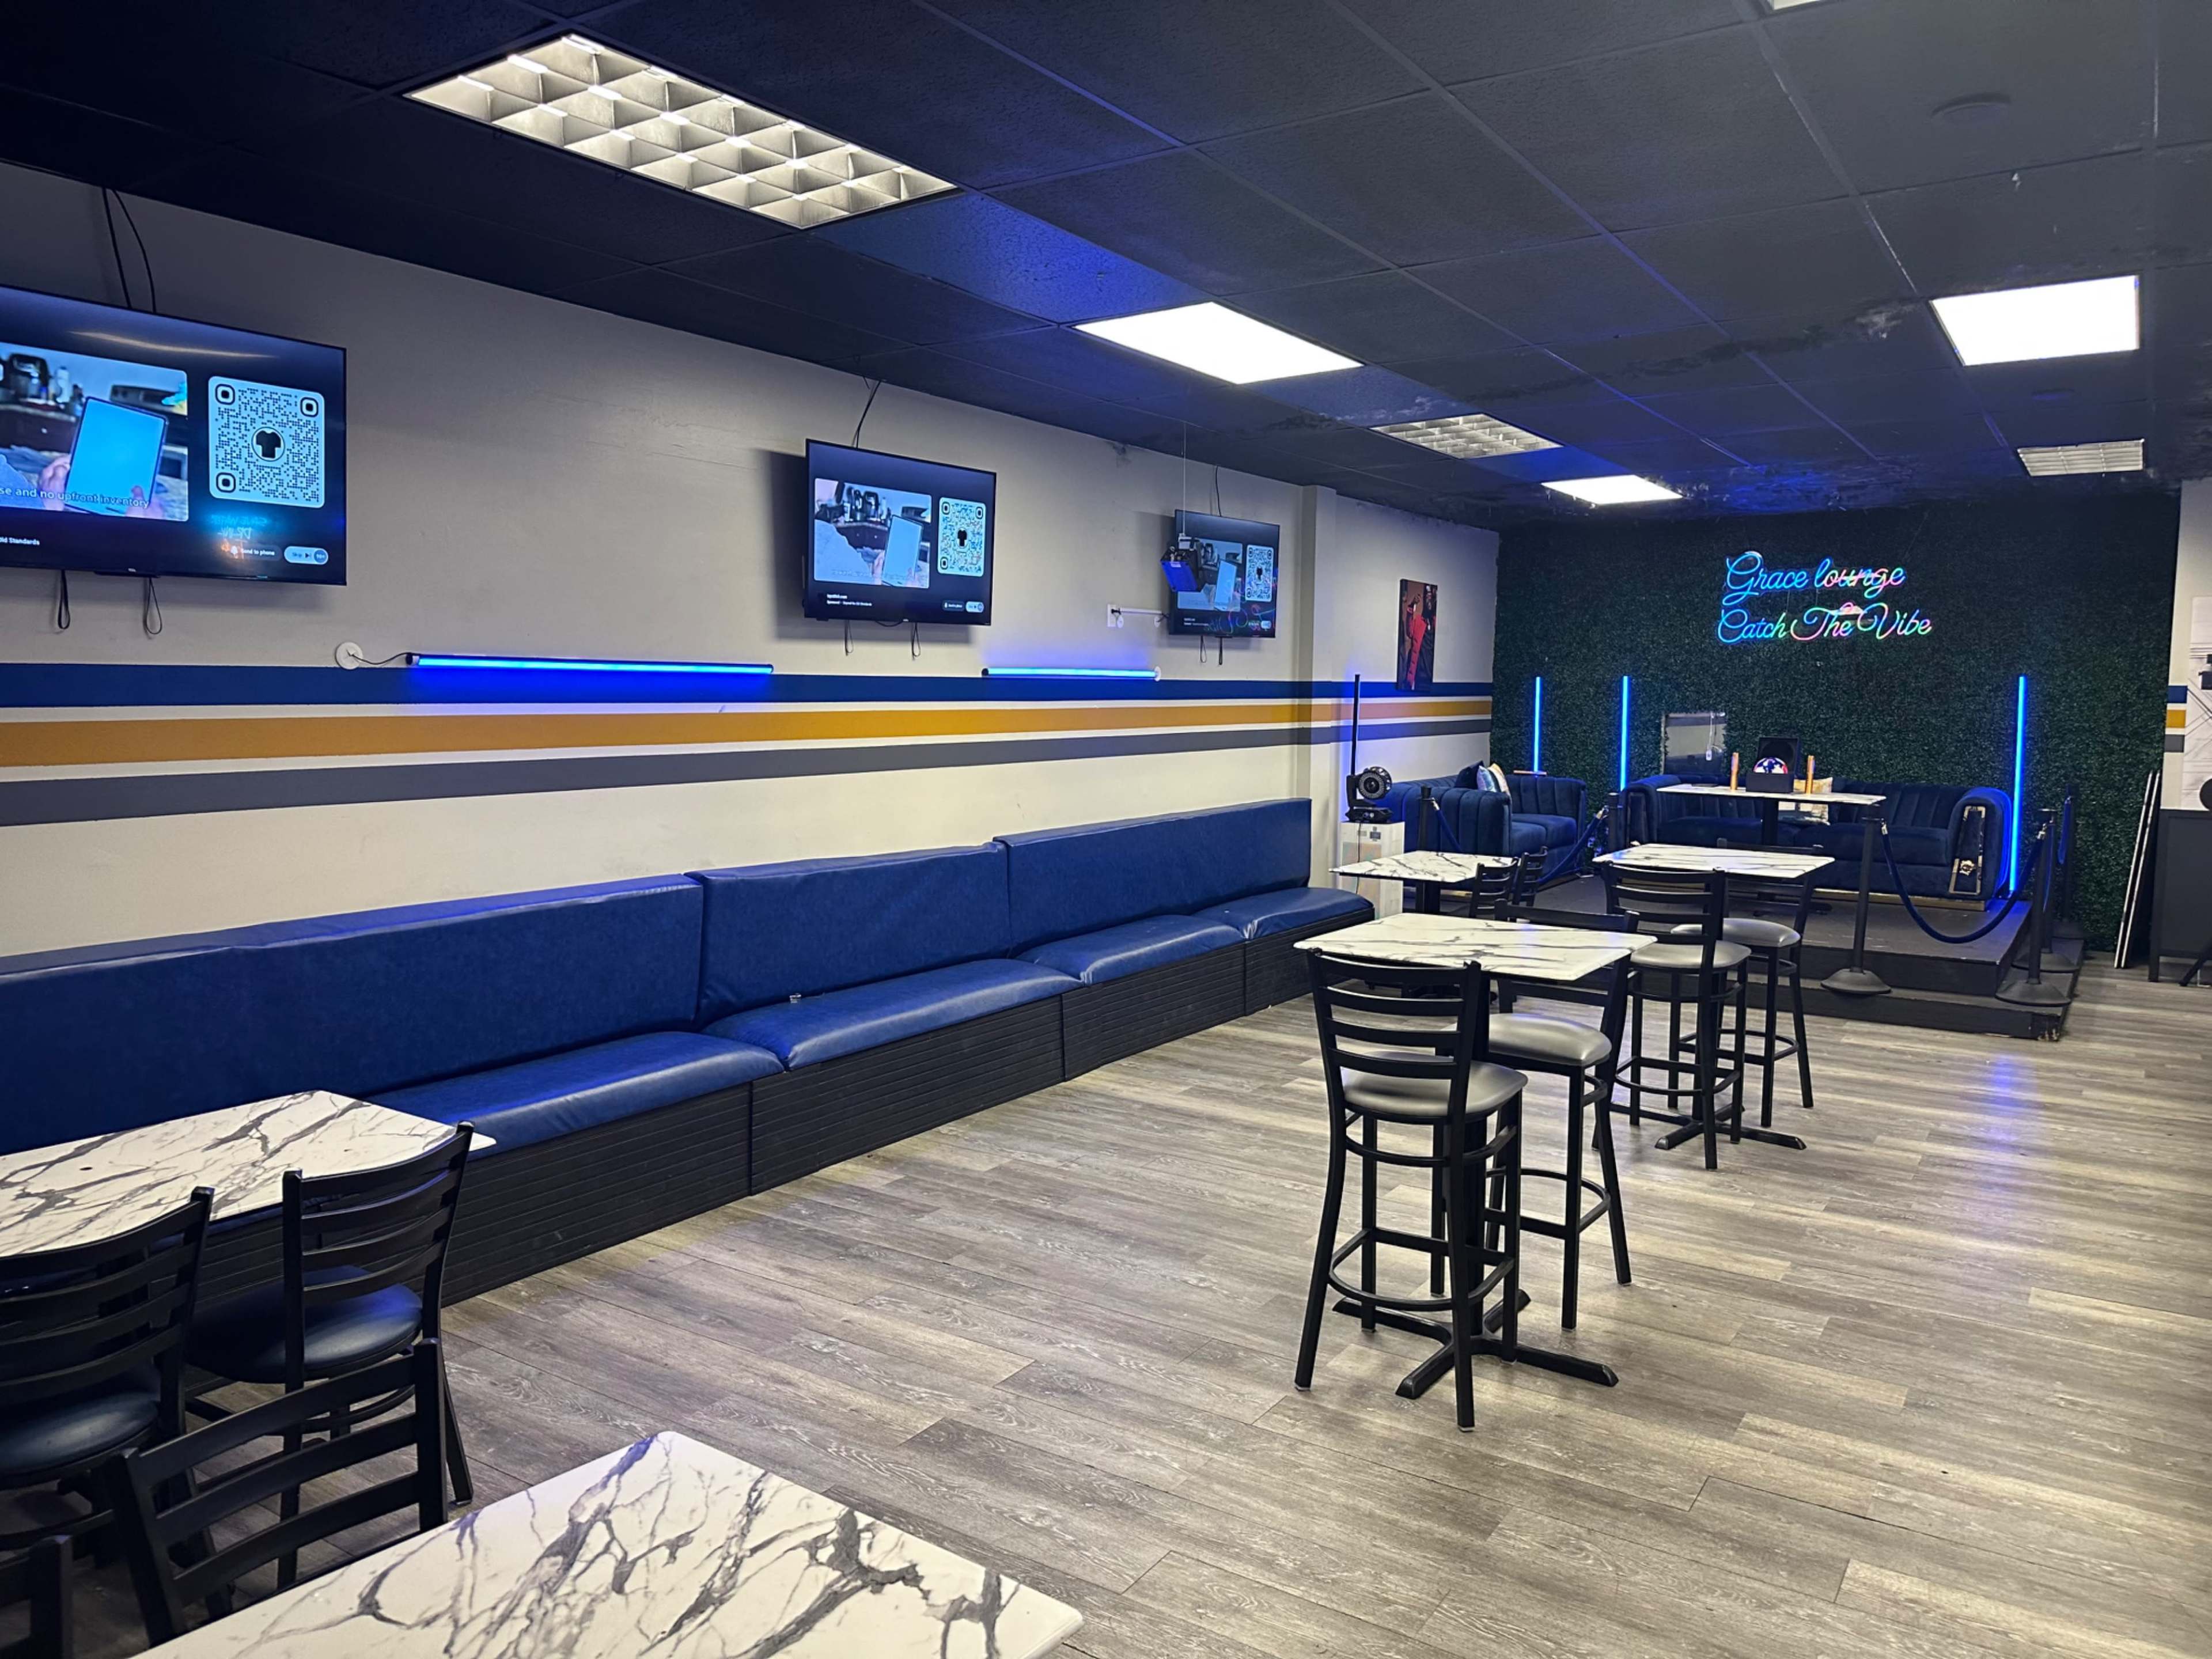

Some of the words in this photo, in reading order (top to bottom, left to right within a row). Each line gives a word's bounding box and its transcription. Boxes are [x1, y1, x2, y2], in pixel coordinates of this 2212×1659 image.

[16, 488, 37, 498] and
[40, 491, 55, 499] no
[58, 491, 99, 503] upfront
[100, 496, 150, 508] inventory
[1721, 550, 1810, 606] Grace
[1813, 556, 1906, 599] lounge
[1717, 608, 1789, 643] Catch
[1791, 603, 1854, 641] The
[1856, 602, 1933, 640] Vibe
